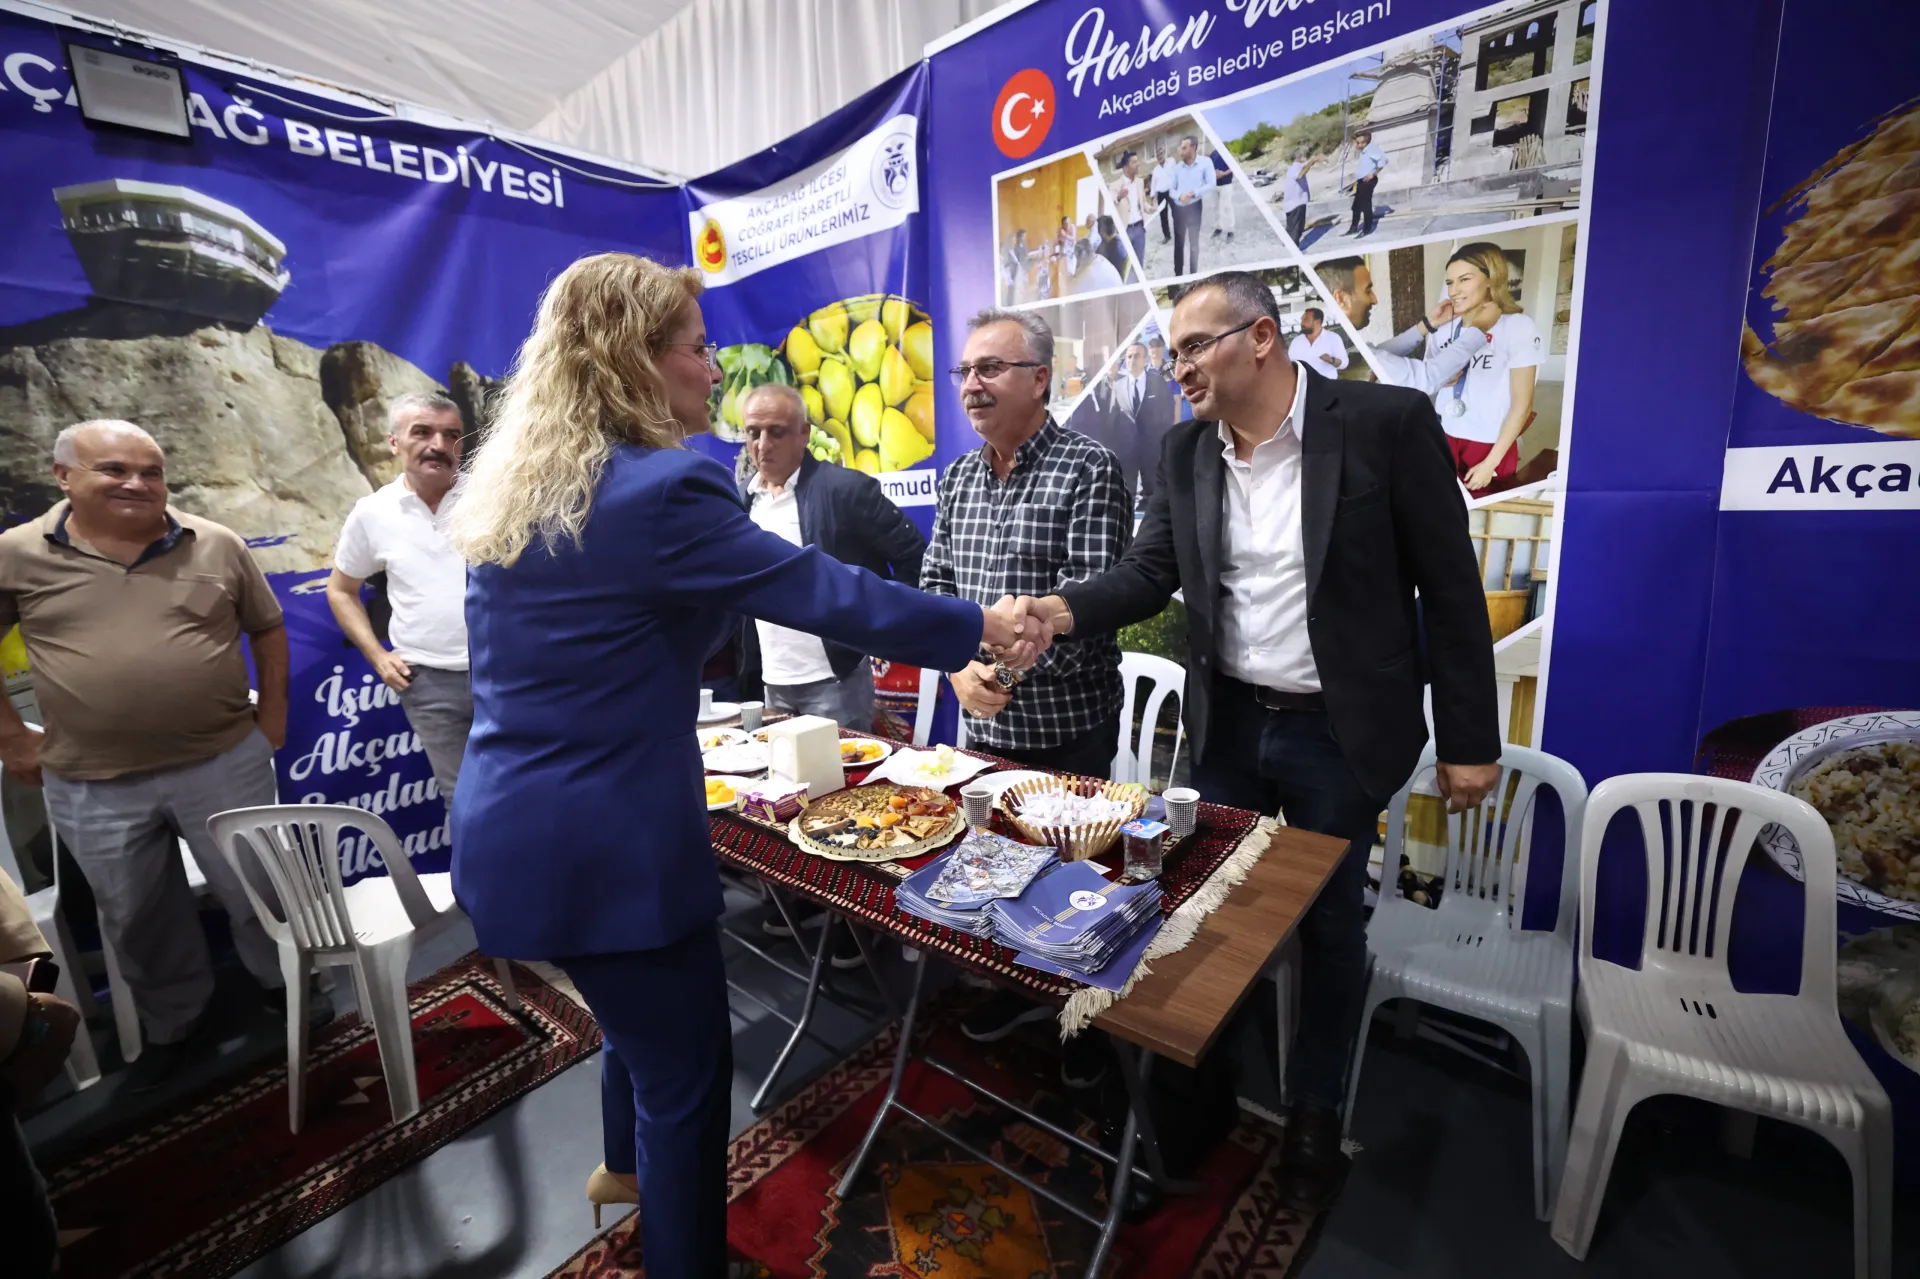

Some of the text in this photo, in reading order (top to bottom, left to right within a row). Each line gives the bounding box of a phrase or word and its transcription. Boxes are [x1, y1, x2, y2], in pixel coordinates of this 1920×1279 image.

[1065, 7, 1216, 98] Hasan
[1098, 71, 1180, 119] Akçadağ
[1187, 40, 1284, 86] Belediye
[283, 118, 565, 208] BELEDİYESİ
[1765, 455, 1920, 499] Akça
